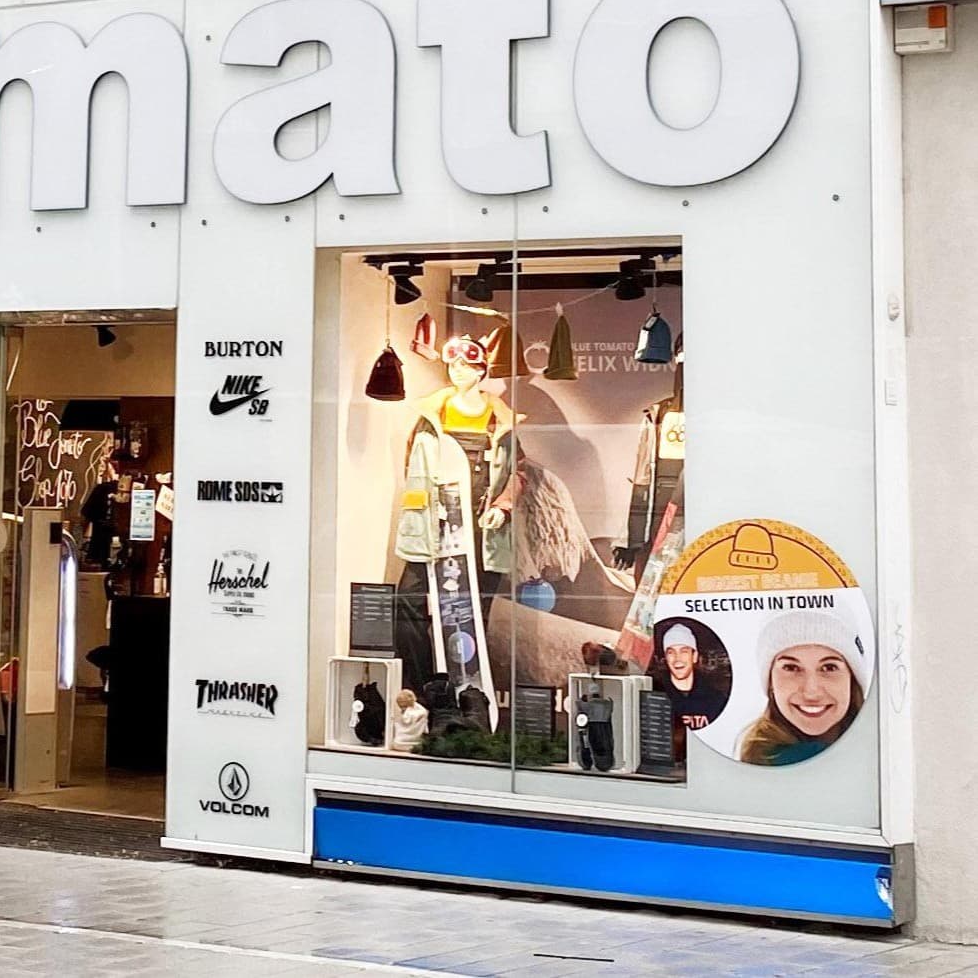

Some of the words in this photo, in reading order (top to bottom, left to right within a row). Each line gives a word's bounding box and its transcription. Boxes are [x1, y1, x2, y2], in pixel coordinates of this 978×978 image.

[204, 340, 284, 357] BURTON
[593, 342, 635, 352] TOMATO
[221, 375, 263, 395] NIKE
[248, 398, 269, 415] SB
[197, 480, 232, 501] ROME
[234, 481, 260, 502] SDS
[207, 559, 270, 595] Herschel
[685, 597, 763, 613] SELECTION
[767, 596, 783, 610] IN
[787, 594, 835, 610] TOWN
[195, 679, 278, 716] THRASHER
[199, 799, 270, 818] VOLCOM
